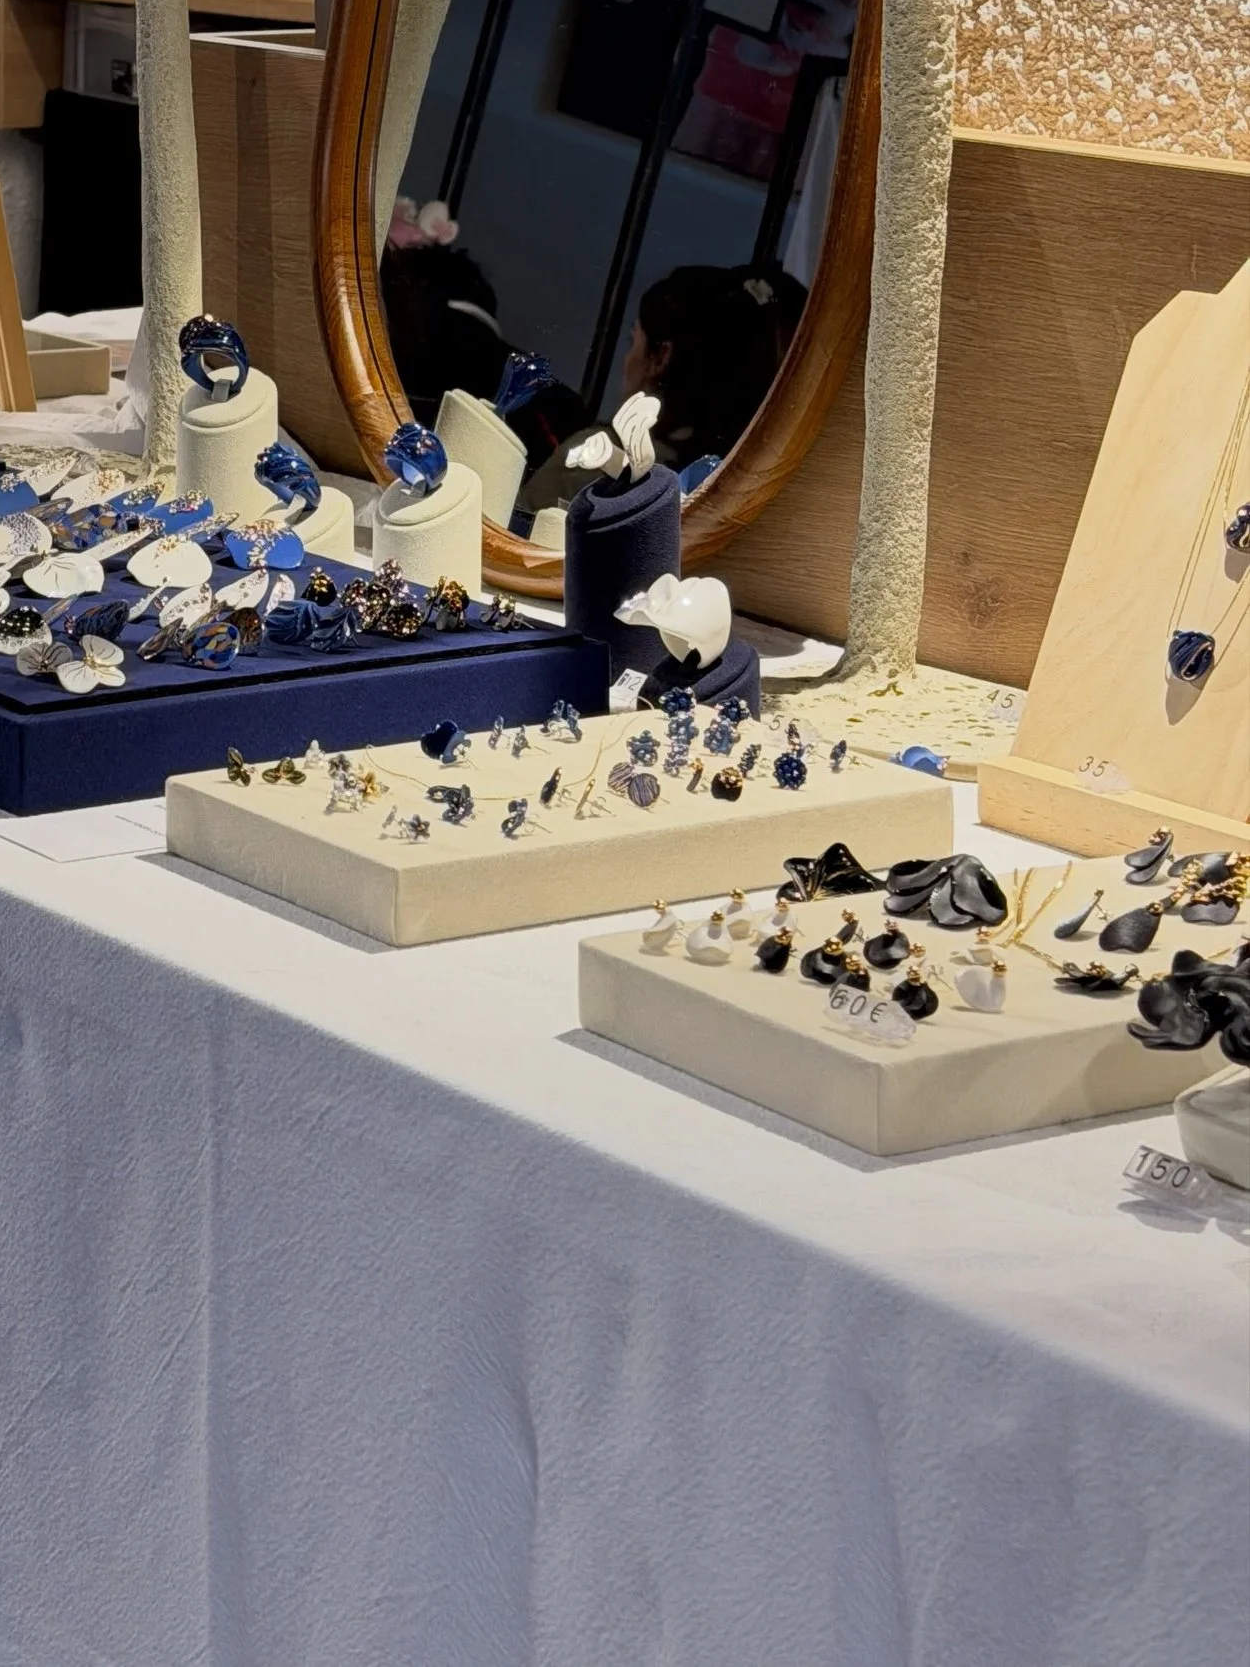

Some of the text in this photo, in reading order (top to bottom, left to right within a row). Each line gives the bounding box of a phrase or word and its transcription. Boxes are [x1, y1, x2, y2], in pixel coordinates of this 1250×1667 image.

[987, 689, 1017, 709] 45
[1078, 755, 1109, 777] 35
[1135, 1150, 1191, 1188] 150
